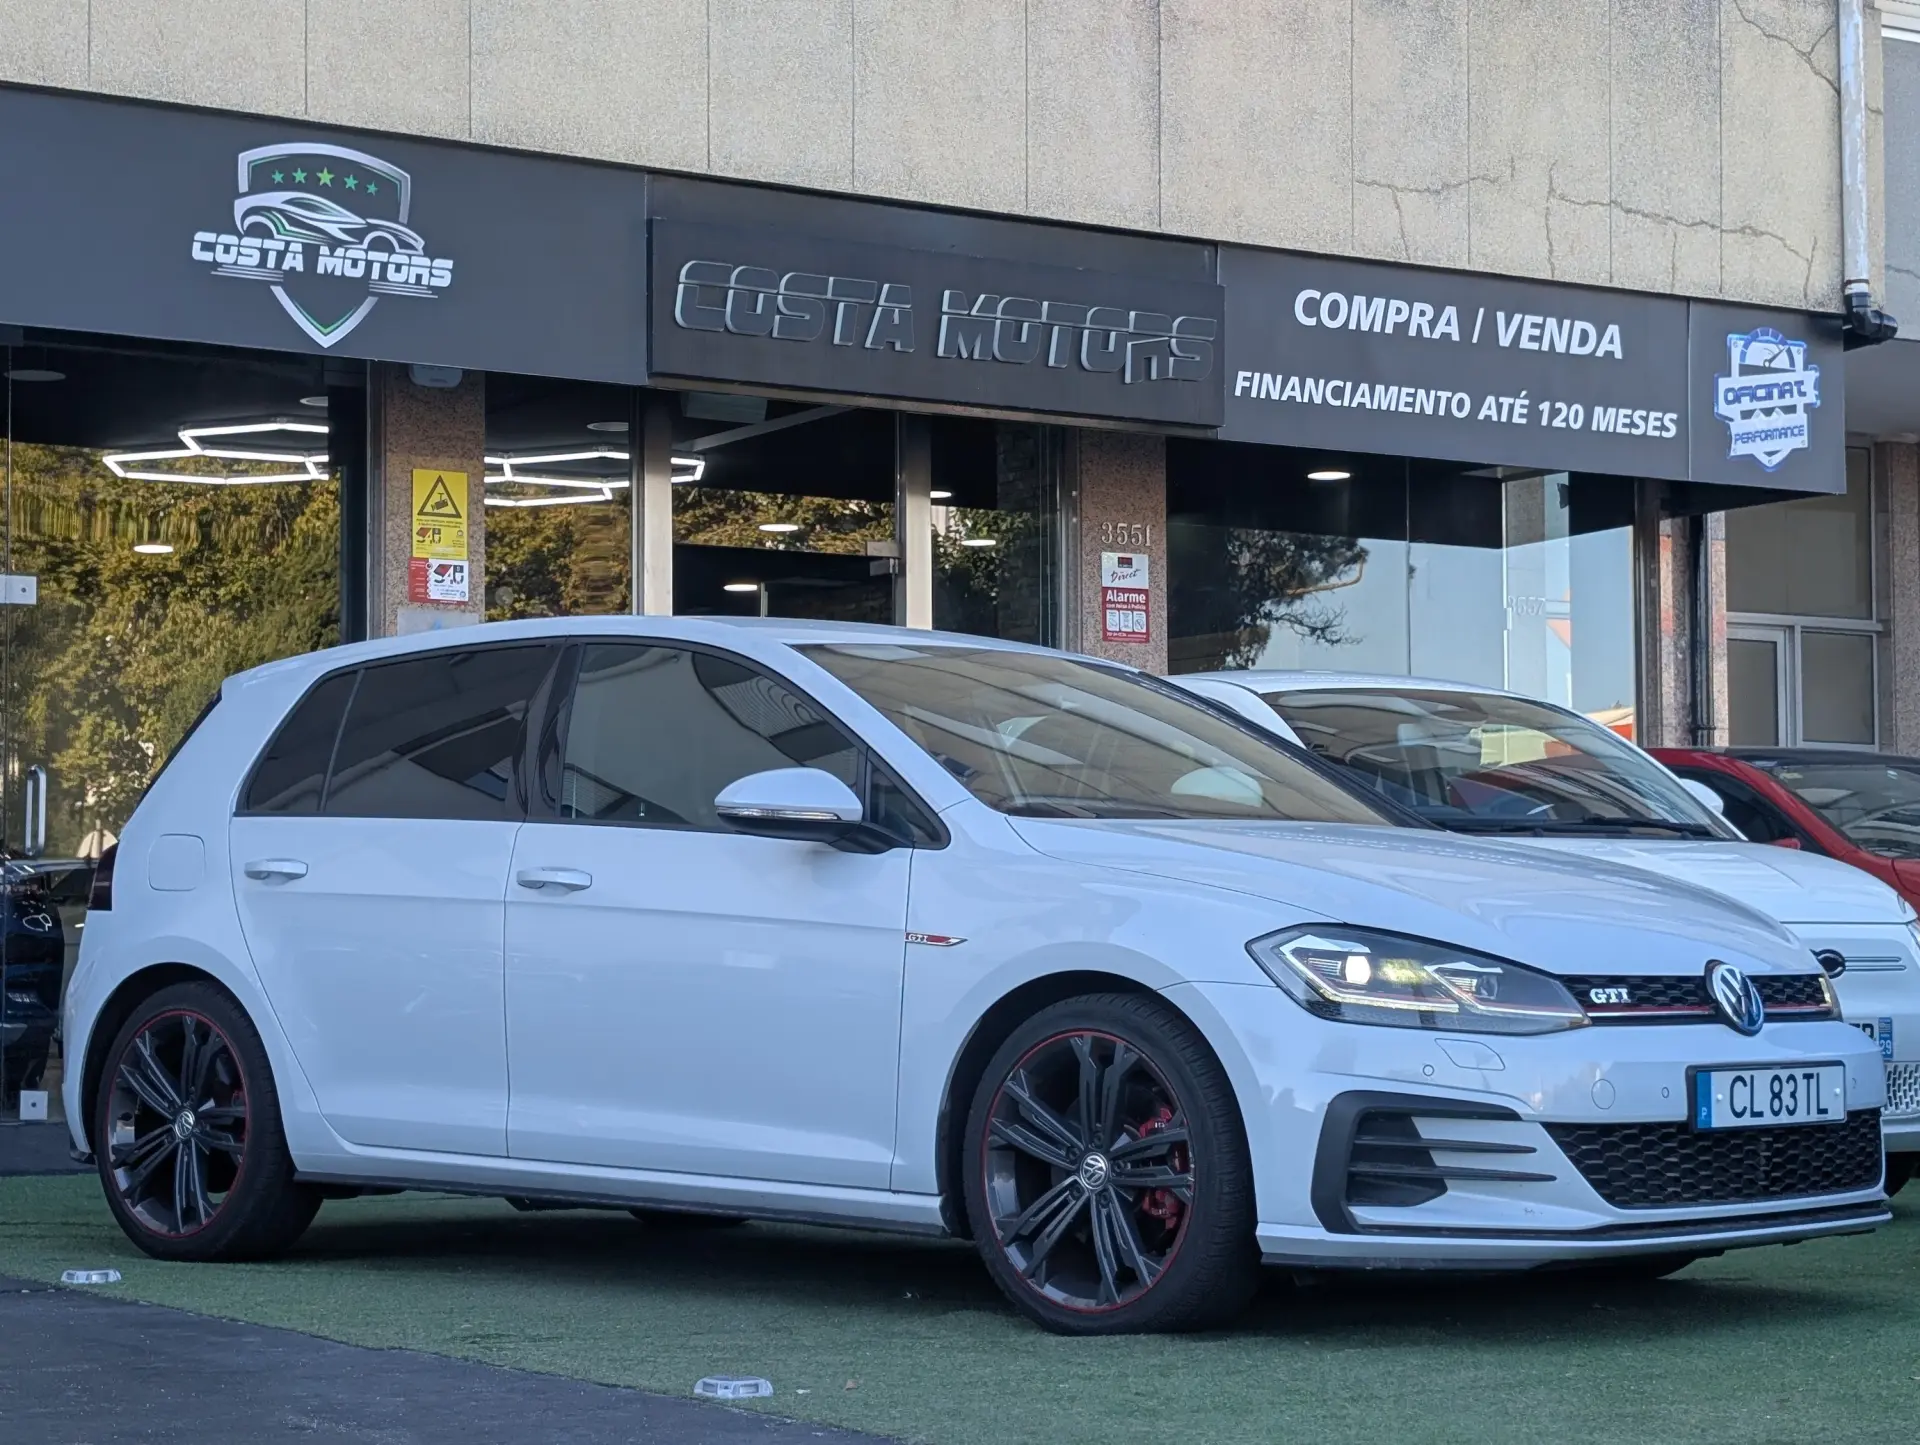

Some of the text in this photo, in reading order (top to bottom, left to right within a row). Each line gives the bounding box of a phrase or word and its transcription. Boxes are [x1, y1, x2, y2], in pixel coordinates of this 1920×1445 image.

[192, 231, 454, 287] COSTA MOTORS
[674, 260, 1218, 384] COSTA MOTORS
[1294, 289, 1623, 359] COMPRA / VENDA
[1234, 370, 1678, 439] FINANCIAMENTO ATÉ 120 MESES
[1734, 425, 1805, 446] PERFORMANCE
[1101, 521, 1151, 546] 3551
[1111, 568, 1141, 583] Direct
[1106, 590, 1146, 604] Alarme
[908, 934, 928, 943] GTI
[1589, 988, 1632, 1004] GTI
[1729, 1072, 1829, 1119] CL 83 TL
[1701, 1107, 1708, 1120] P
